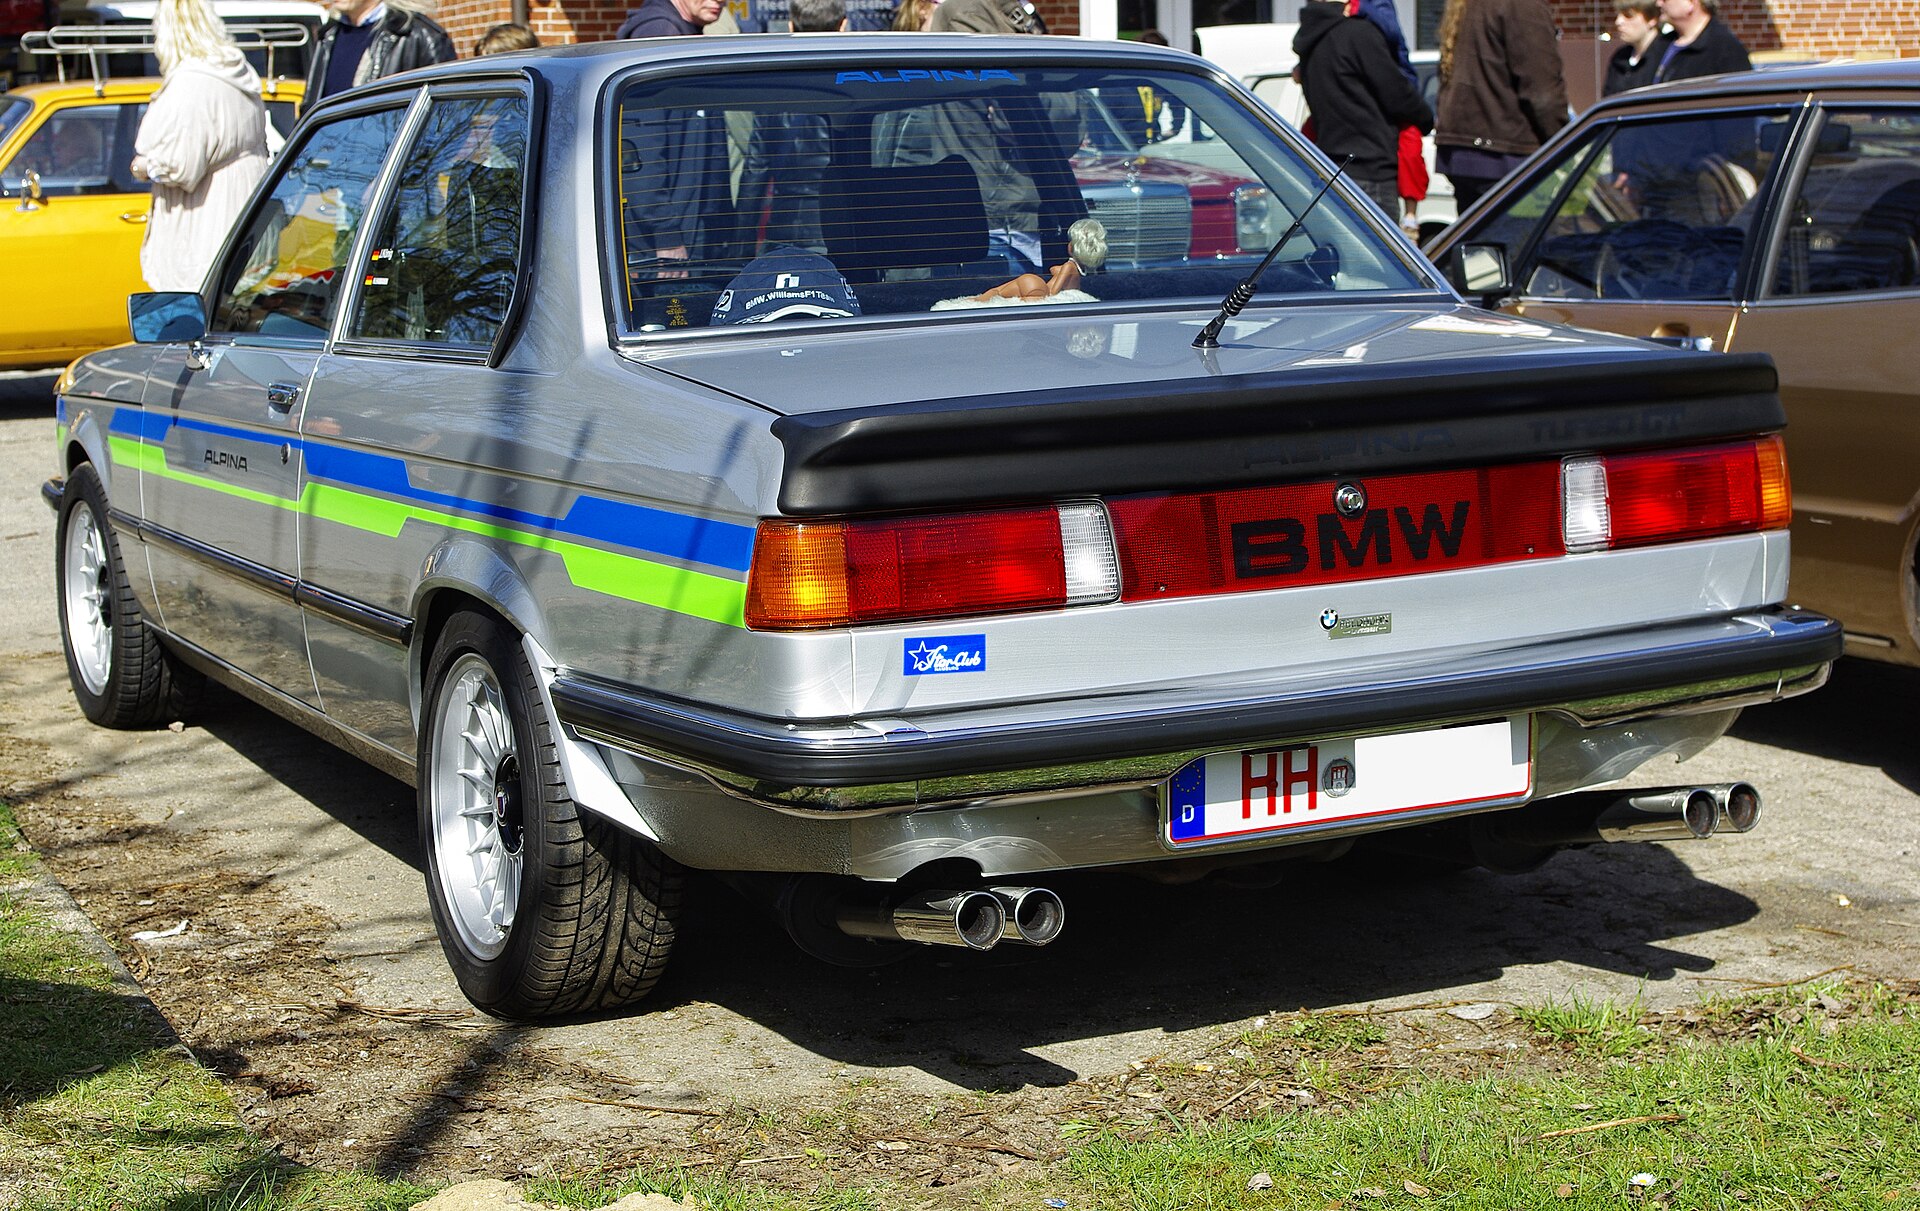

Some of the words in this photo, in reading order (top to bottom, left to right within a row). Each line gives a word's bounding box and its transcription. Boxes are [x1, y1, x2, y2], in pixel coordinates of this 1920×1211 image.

[835, 69, 1019, 85] ALPINA
[204, 449, 248, 472] ALPINA
[1244, 428, 1456, 470] ALPINA
[1231, 501, 1470, 579] BMW
[1241, 746, 1319, 819] HH
[1181, 804, 1195, 823] D
